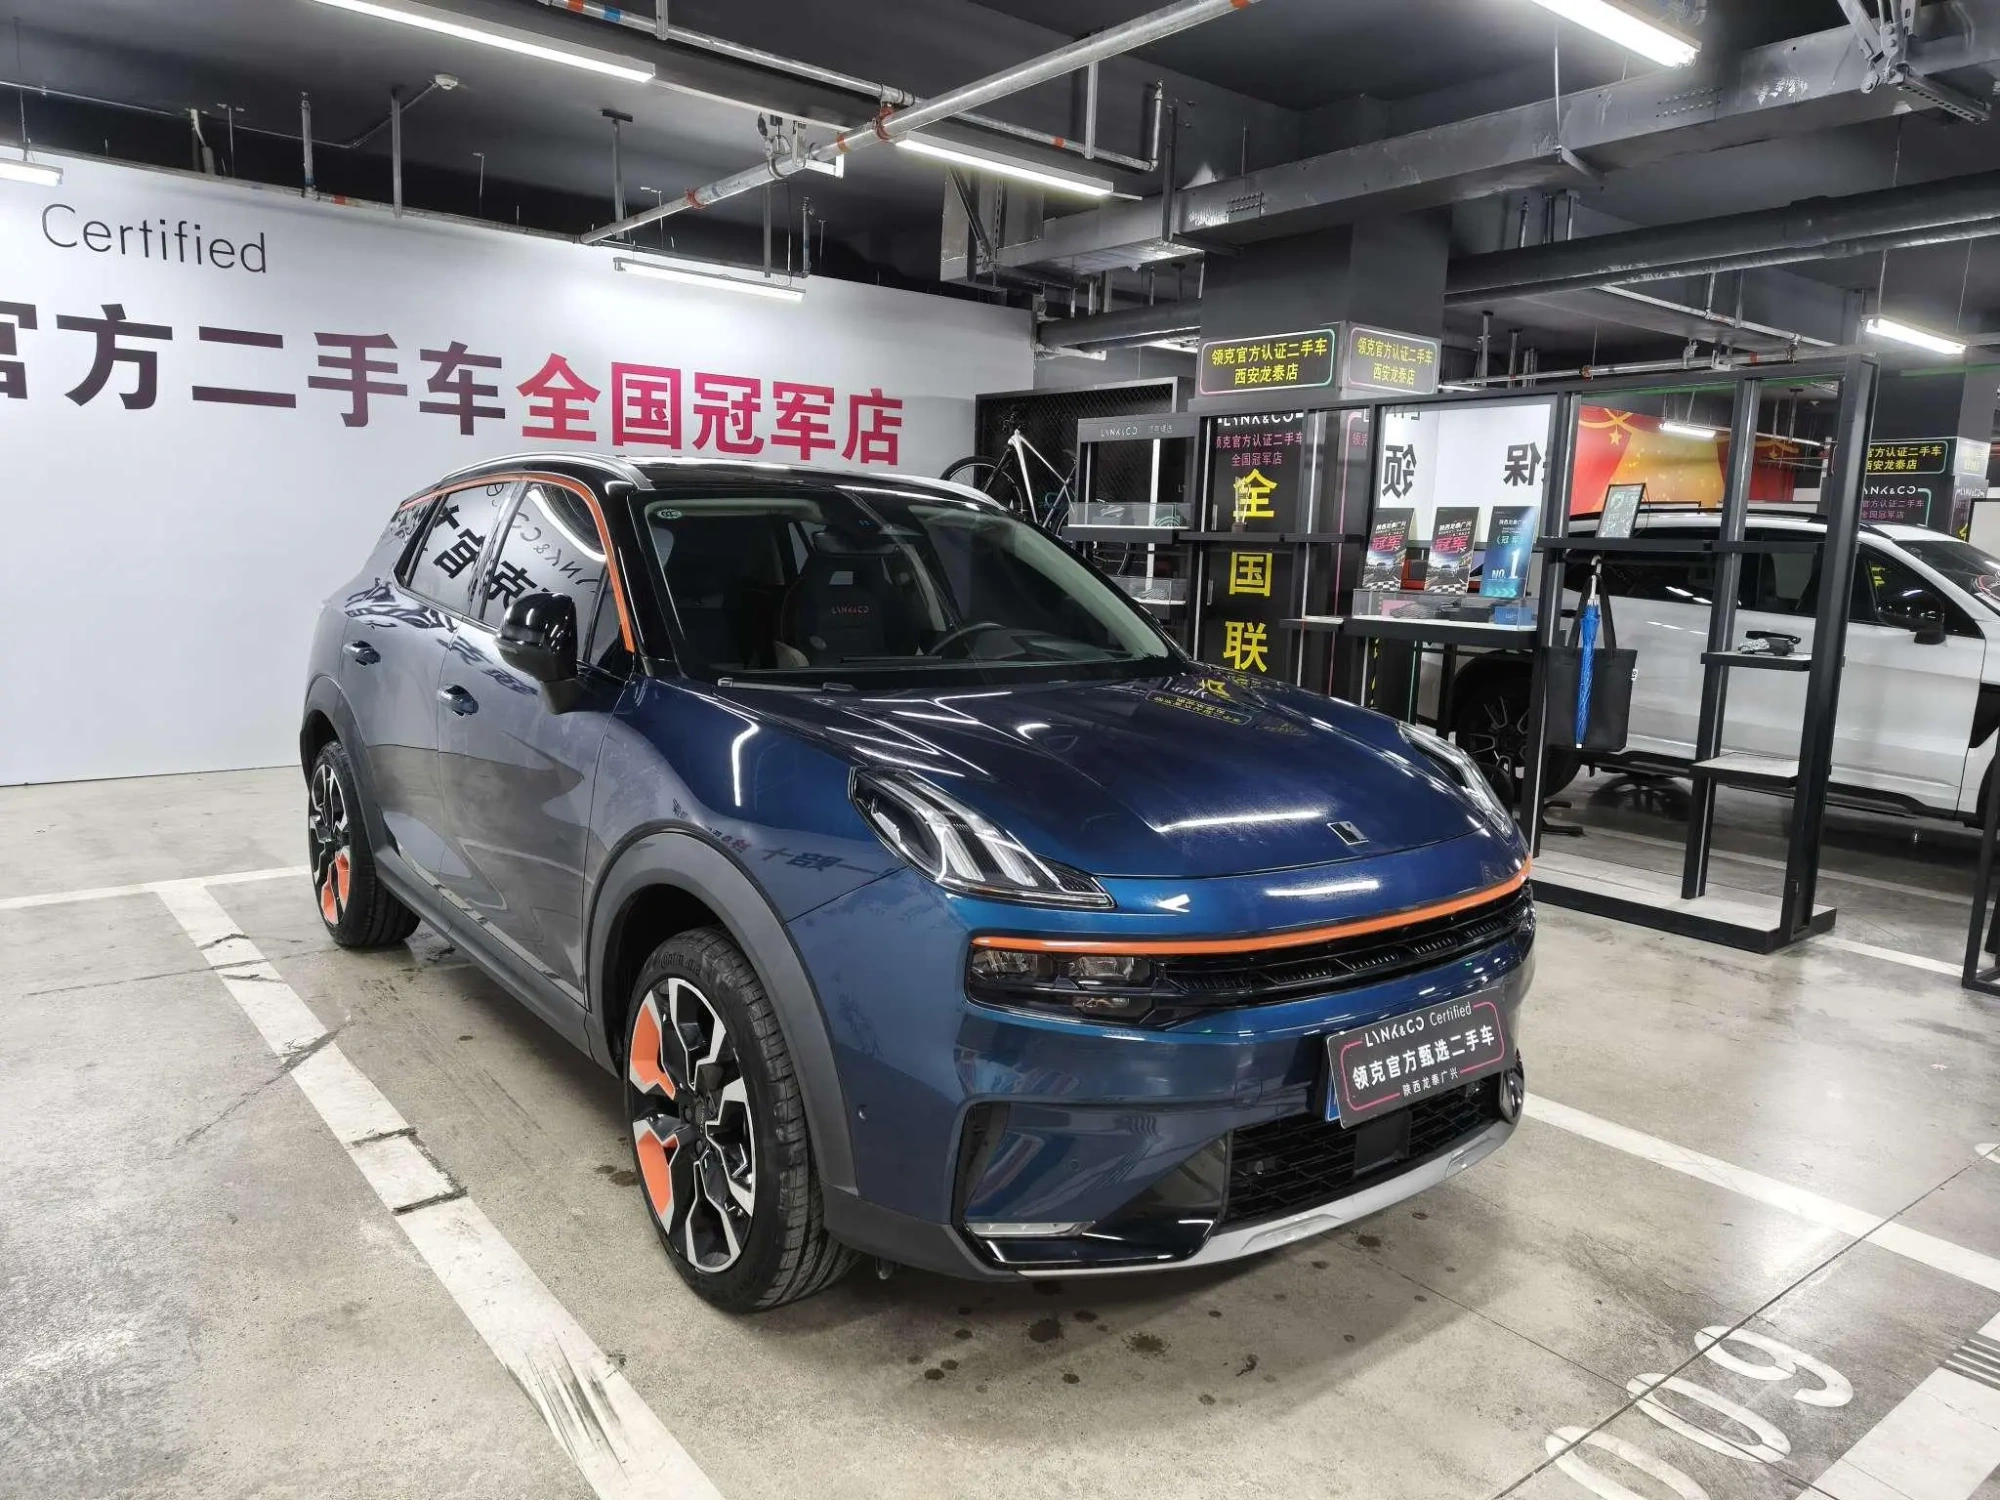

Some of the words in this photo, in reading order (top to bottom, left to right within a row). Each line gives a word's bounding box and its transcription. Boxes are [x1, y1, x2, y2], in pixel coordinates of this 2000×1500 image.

[41, 203, 266, 273] Certified
[1211, 337, 1328, 366] 领克官方认证二手车
[1357, 337, 1433, 366] 领克官方认证二手车
[1234, 363, 1299, 385] 西安龙泰店
[1372, 363, 1416, 387] 西安龙泰店
[1231, 452, 1283, 467] 全国冠军店
[1429, 1002, 1472, 1026] Certified
[1352, 1025, 1495, 1091] 领克官方甄选二手车
[1402, 1067, 1459, 1097] 陕西龙泰广兴
